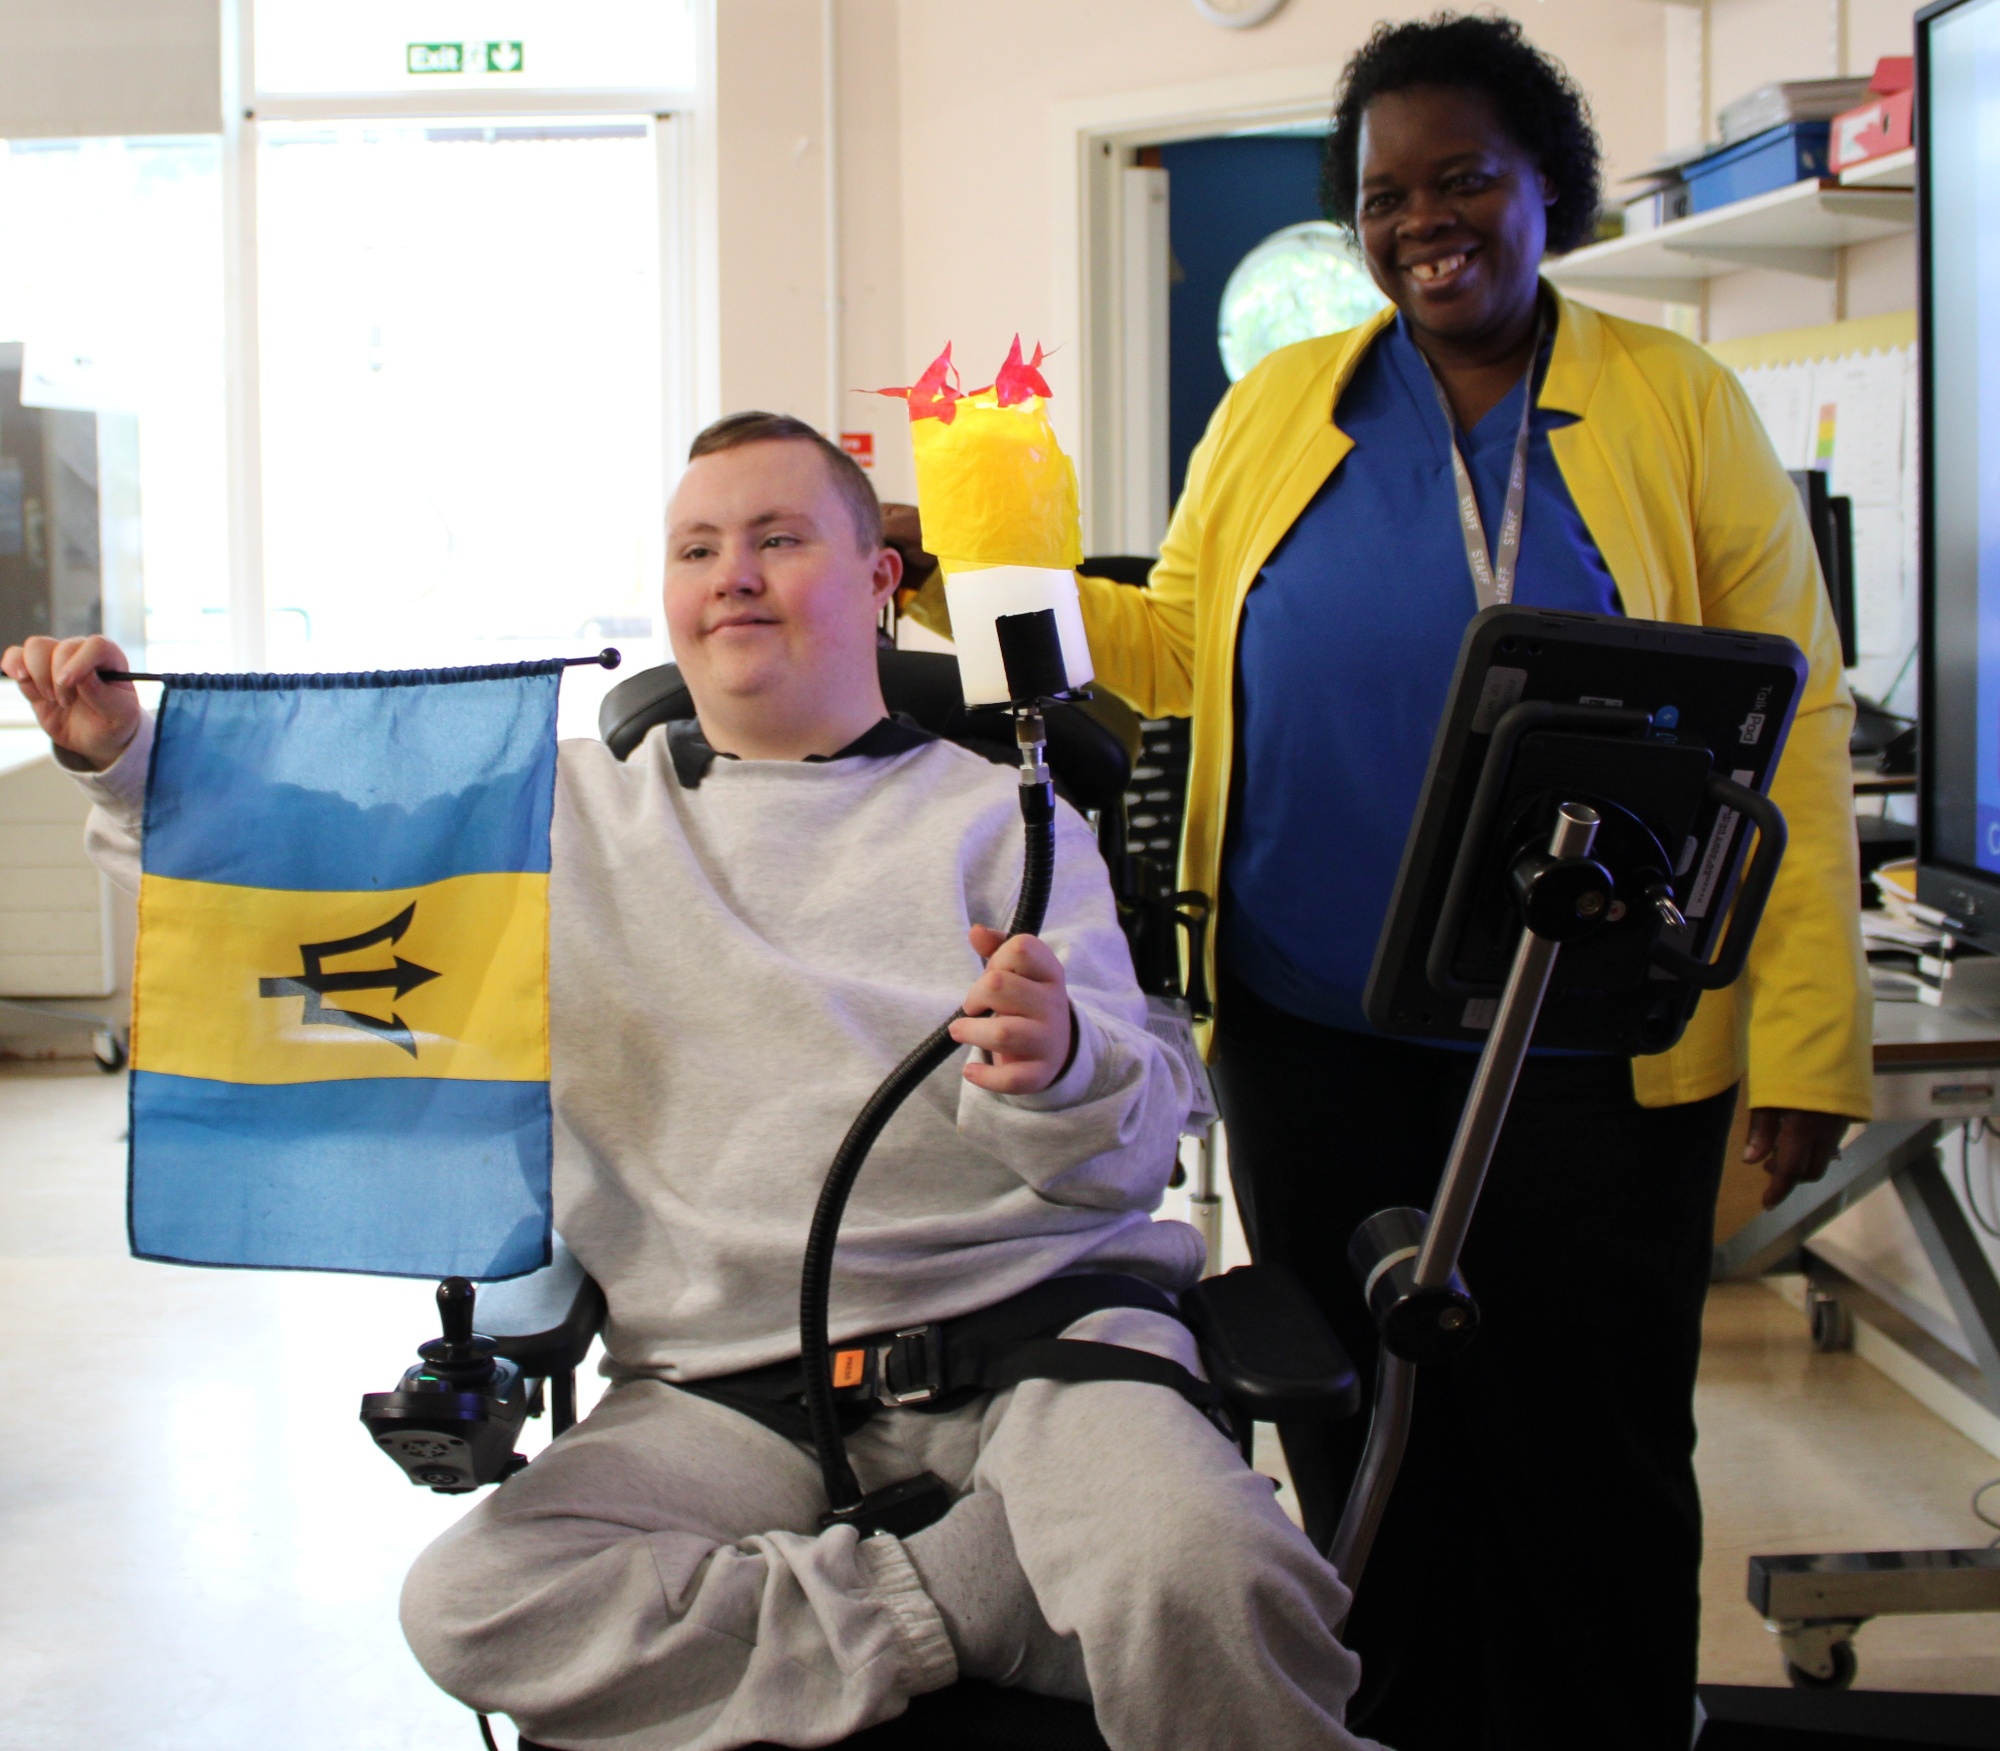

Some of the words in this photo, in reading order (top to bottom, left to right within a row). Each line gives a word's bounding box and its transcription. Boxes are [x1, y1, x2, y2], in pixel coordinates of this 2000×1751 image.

[410, 45, 459, 71] Exit
[1462, 495, 1478, 531] STAFF
[1504, 509, 1518, 546] STAFF
[1472, 549, 1490, 585] STAFF
[1754, 685, 1773, 712] Talk
[1743, 714, 1763, 742] Pad
